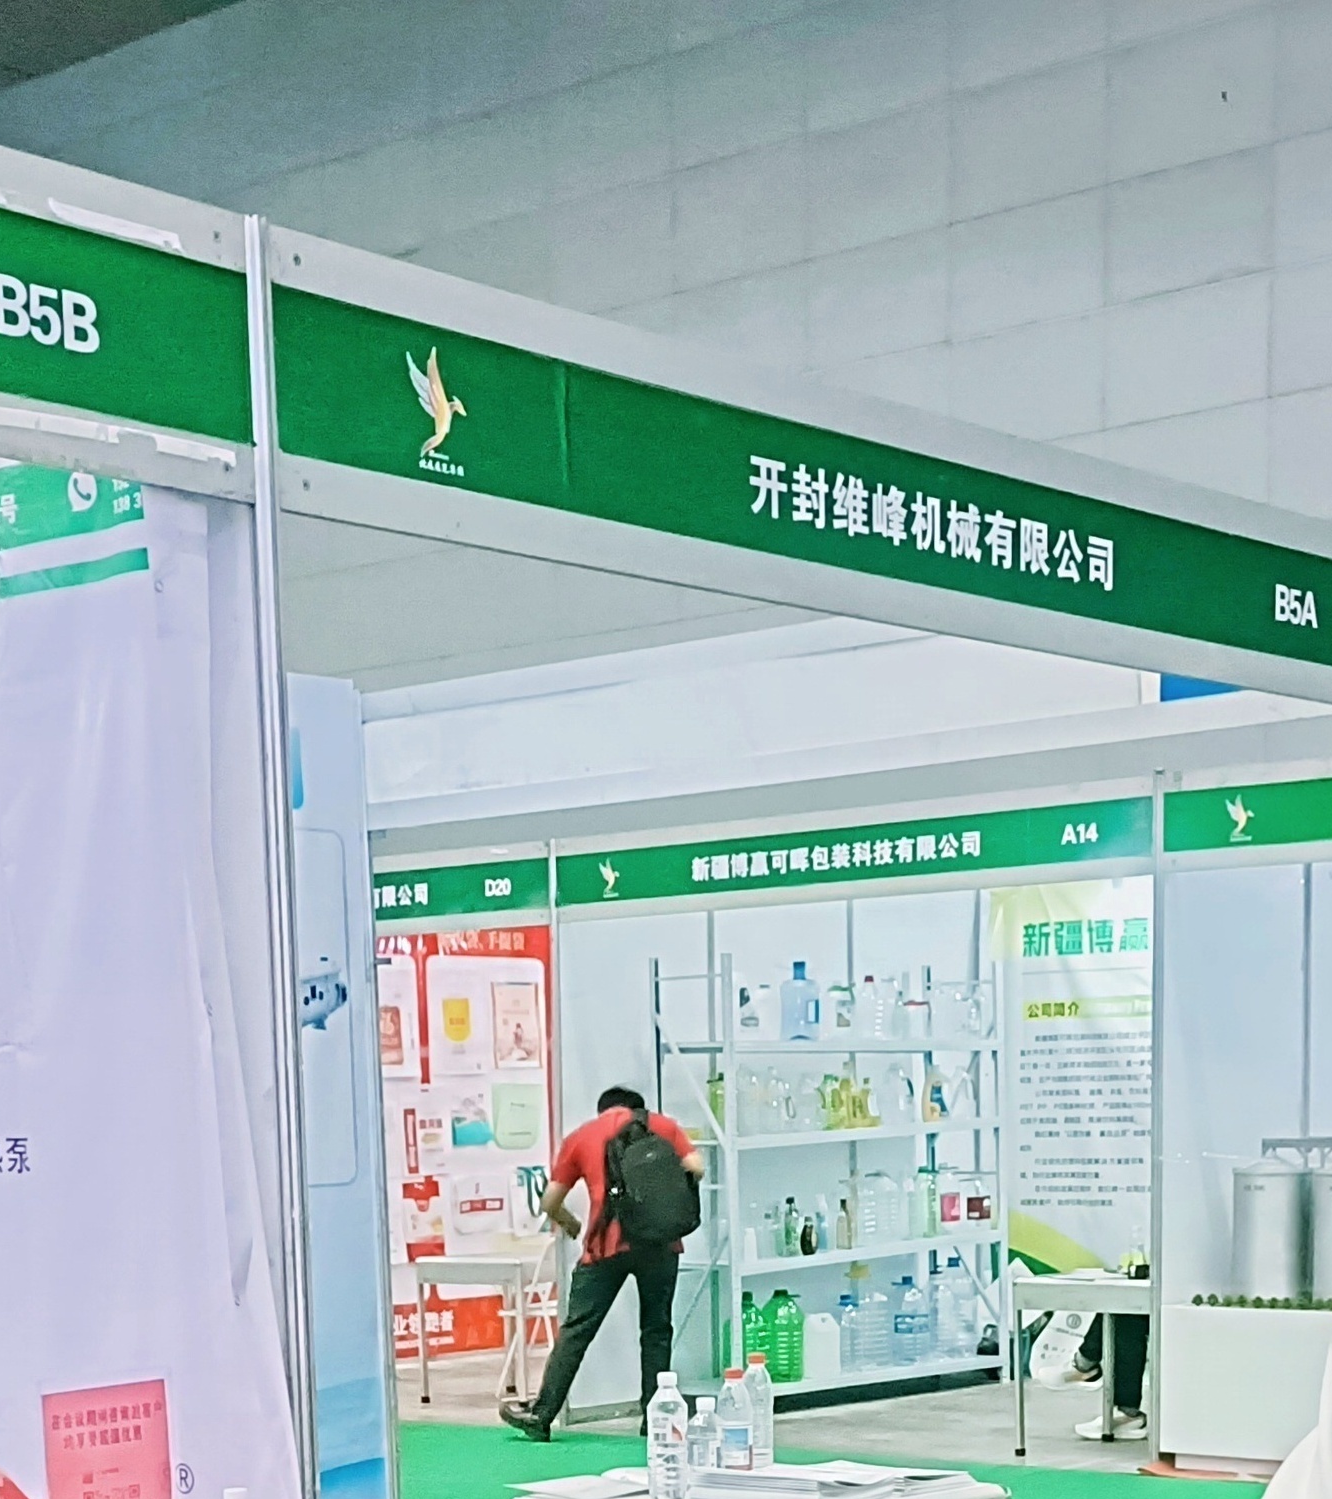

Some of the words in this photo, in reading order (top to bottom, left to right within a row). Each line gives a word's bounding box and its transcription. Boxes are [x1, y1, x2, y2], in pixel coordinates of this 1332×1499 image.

[749, 455, 1114, 591] 开封维峰机械有限公司
[1274, 583, 1318, 629] B5A
[1061, 823, 1099, 845] A14
[484, 877, 512, 897] D20
[1028, 1001, 1079, 1018] 公司简介
